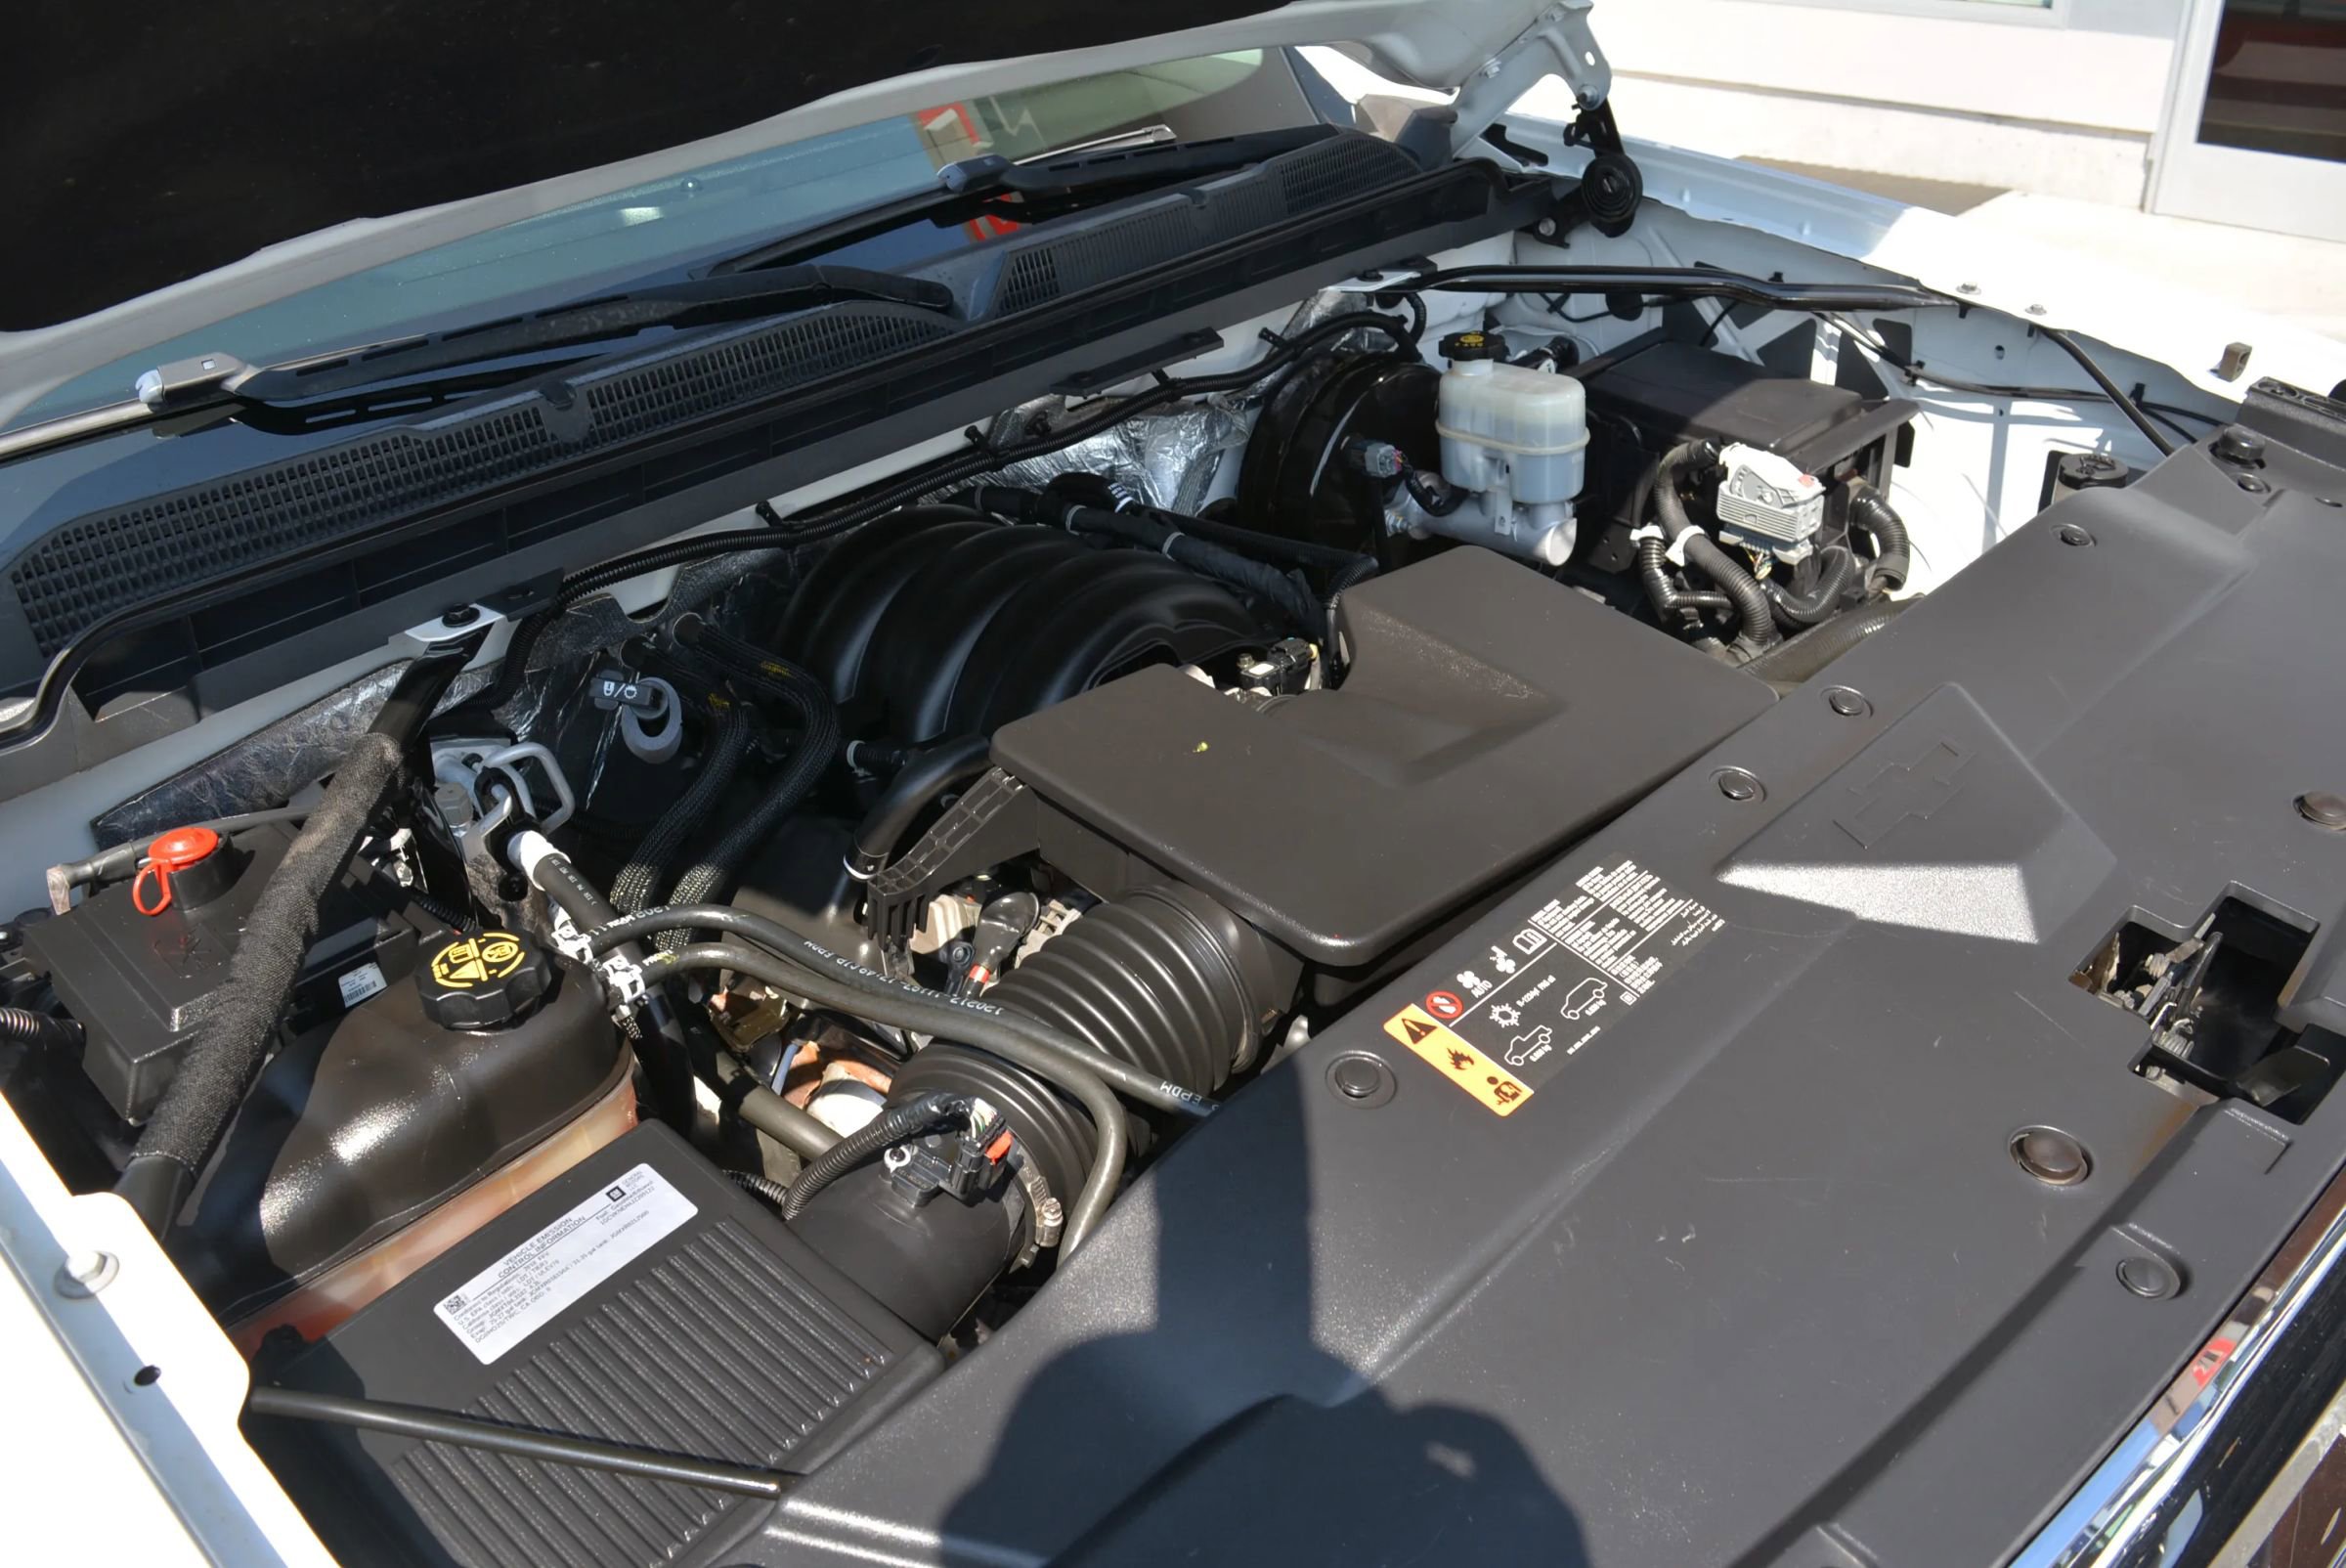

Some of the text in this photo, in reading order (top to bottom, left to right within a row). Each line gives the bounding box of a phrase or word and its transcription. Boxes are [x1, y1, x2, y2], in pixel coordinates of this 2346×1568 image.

[1471, 980, 1493, 998] AUTO
[496, 1214, 586, 1279] CONTROL INFORMATION
[502, 1216, 573, 1266] VEHICLE EMISSION
